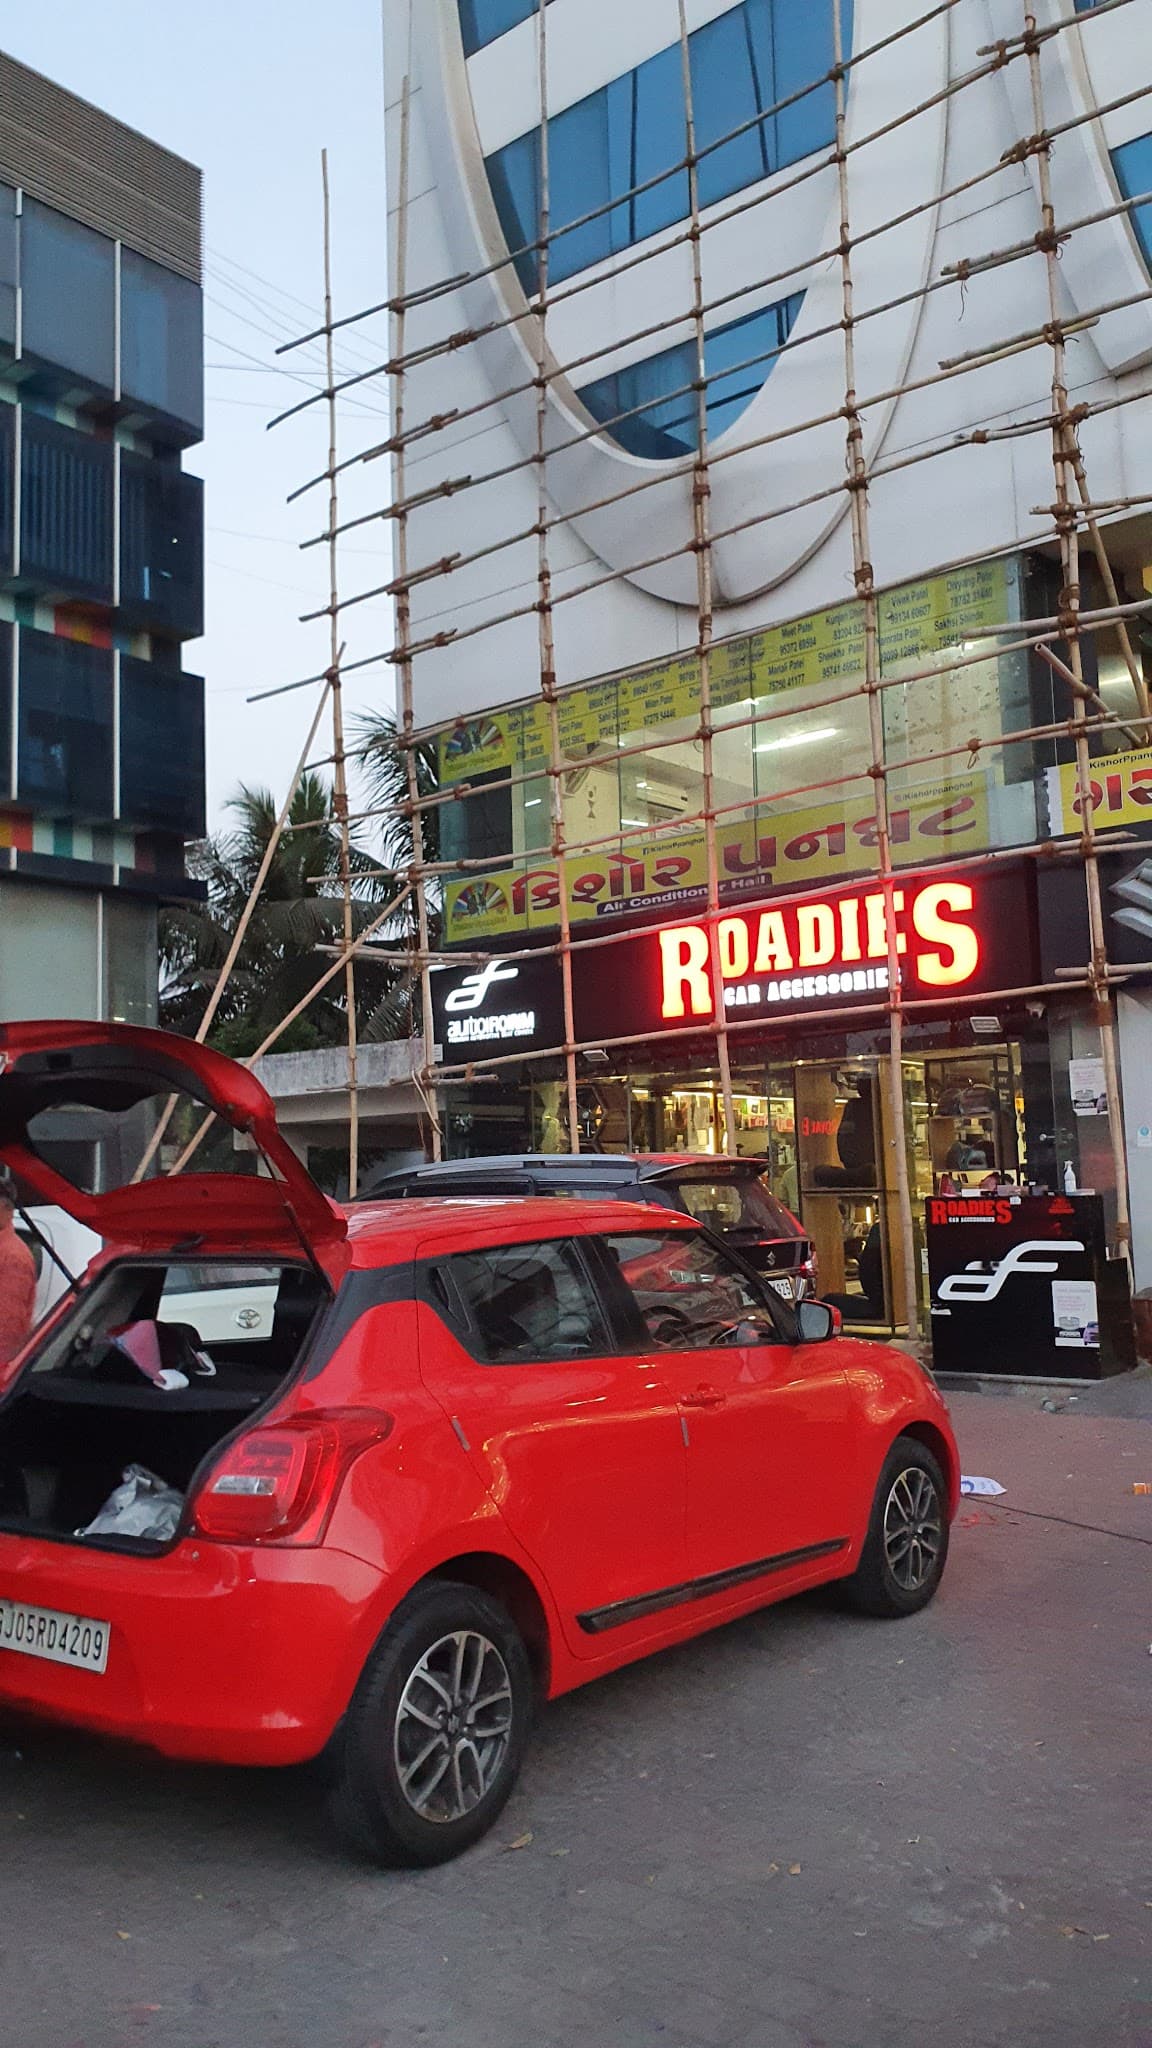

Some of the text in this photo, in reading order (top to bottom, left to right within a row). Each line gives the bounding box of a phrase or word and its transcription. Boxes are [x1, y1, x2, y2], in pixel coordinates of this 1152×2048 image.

[603, 875, 766, 913] Air Conditionr Hall
[659, 882, 979, 1018] ROADIES
[723, 984, 760, 1006] CAR
[931, 1199, 1012, 1225] ROADIES
